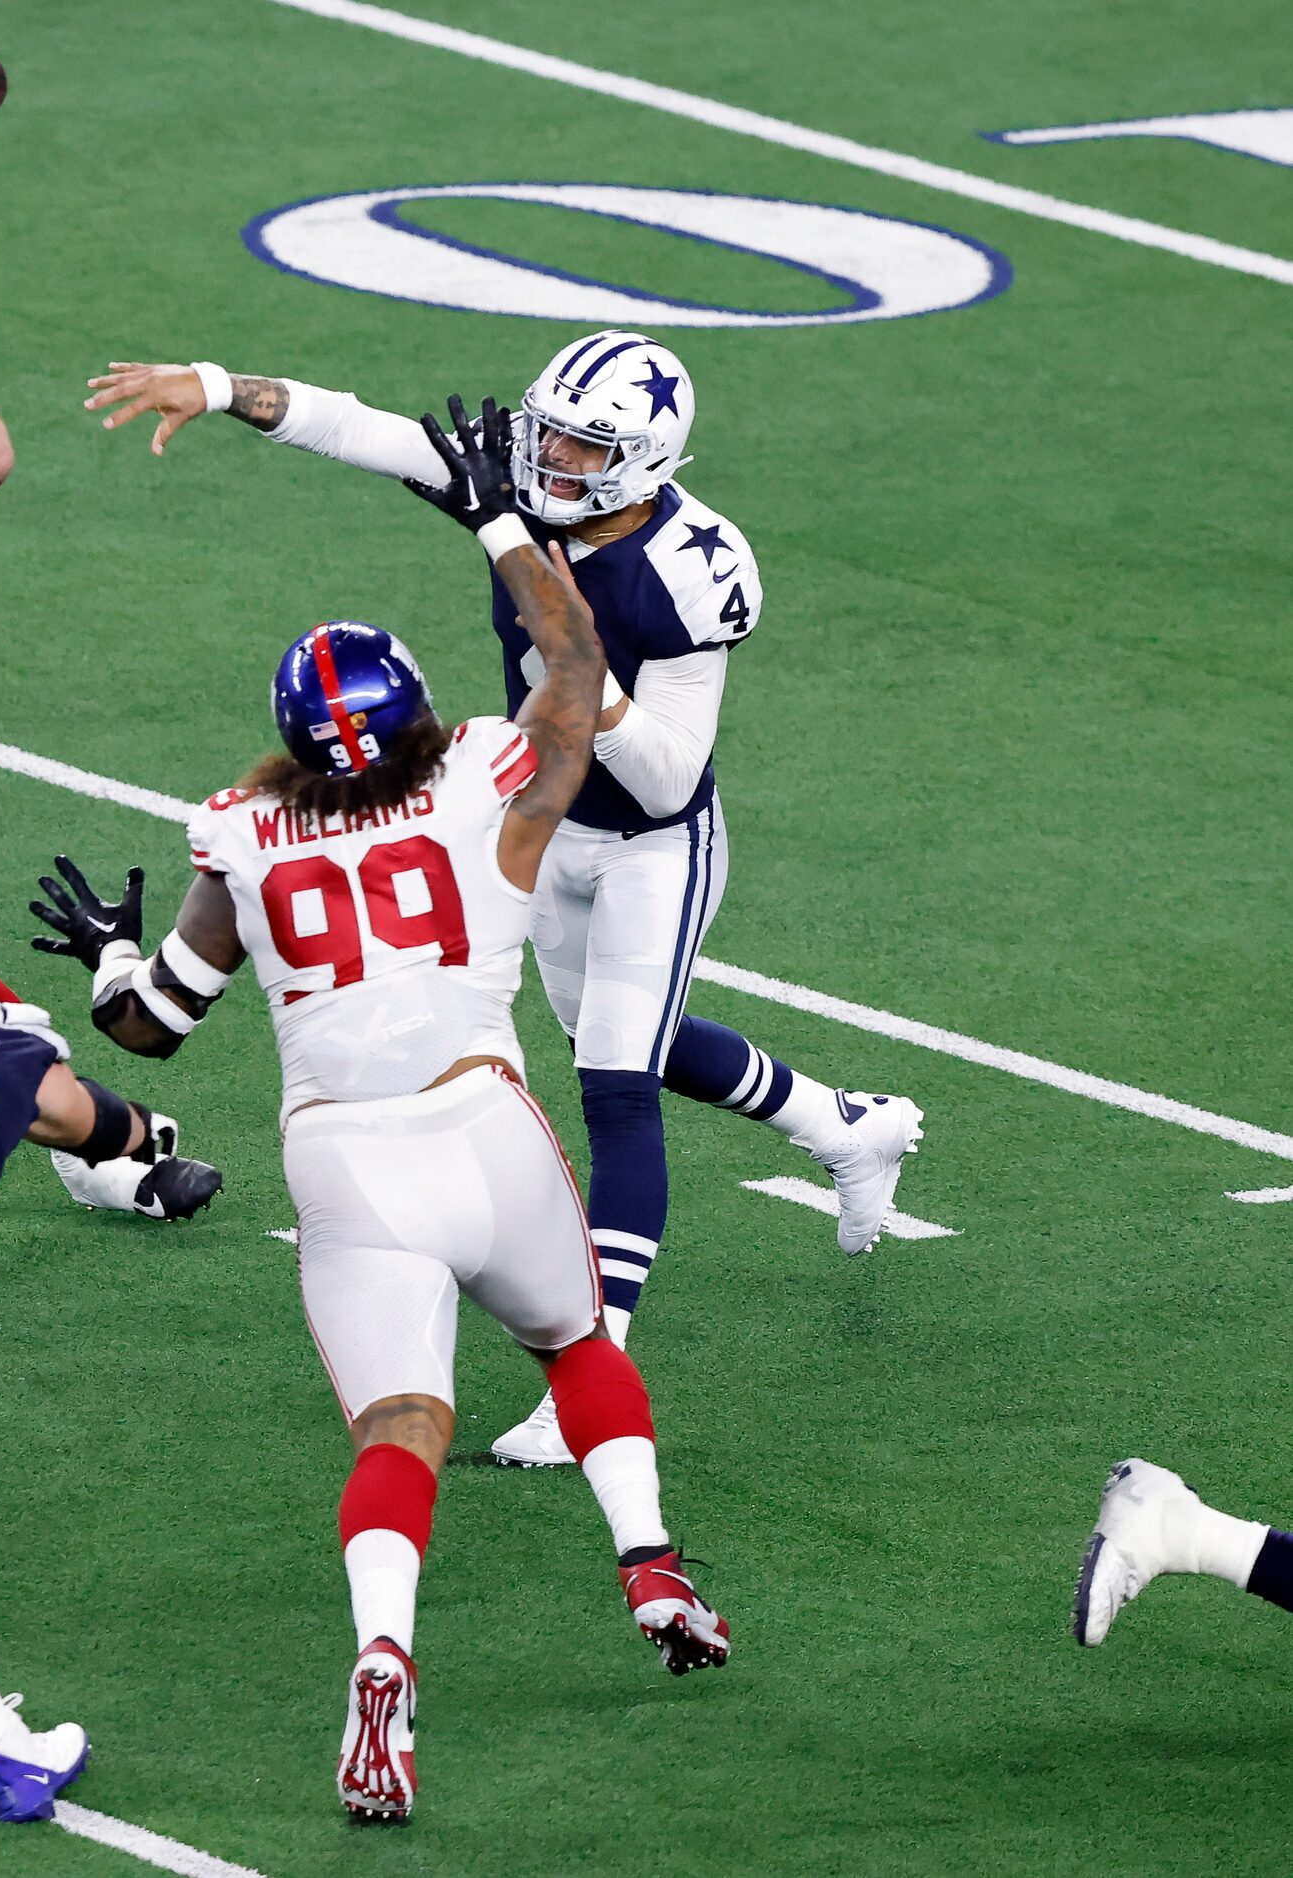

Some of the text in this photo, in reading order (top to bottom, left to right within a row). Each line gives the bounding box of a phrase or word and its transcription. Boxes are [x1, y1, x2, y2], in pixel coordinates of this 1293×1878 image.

[239, 181, 1014, 329] 0
[719, 582, 750, 634] 4
[329, 733, 381, 769] 99
[252, 789, 434, 850] WILLIAMS
[260, 835, 470, 1006] 99
